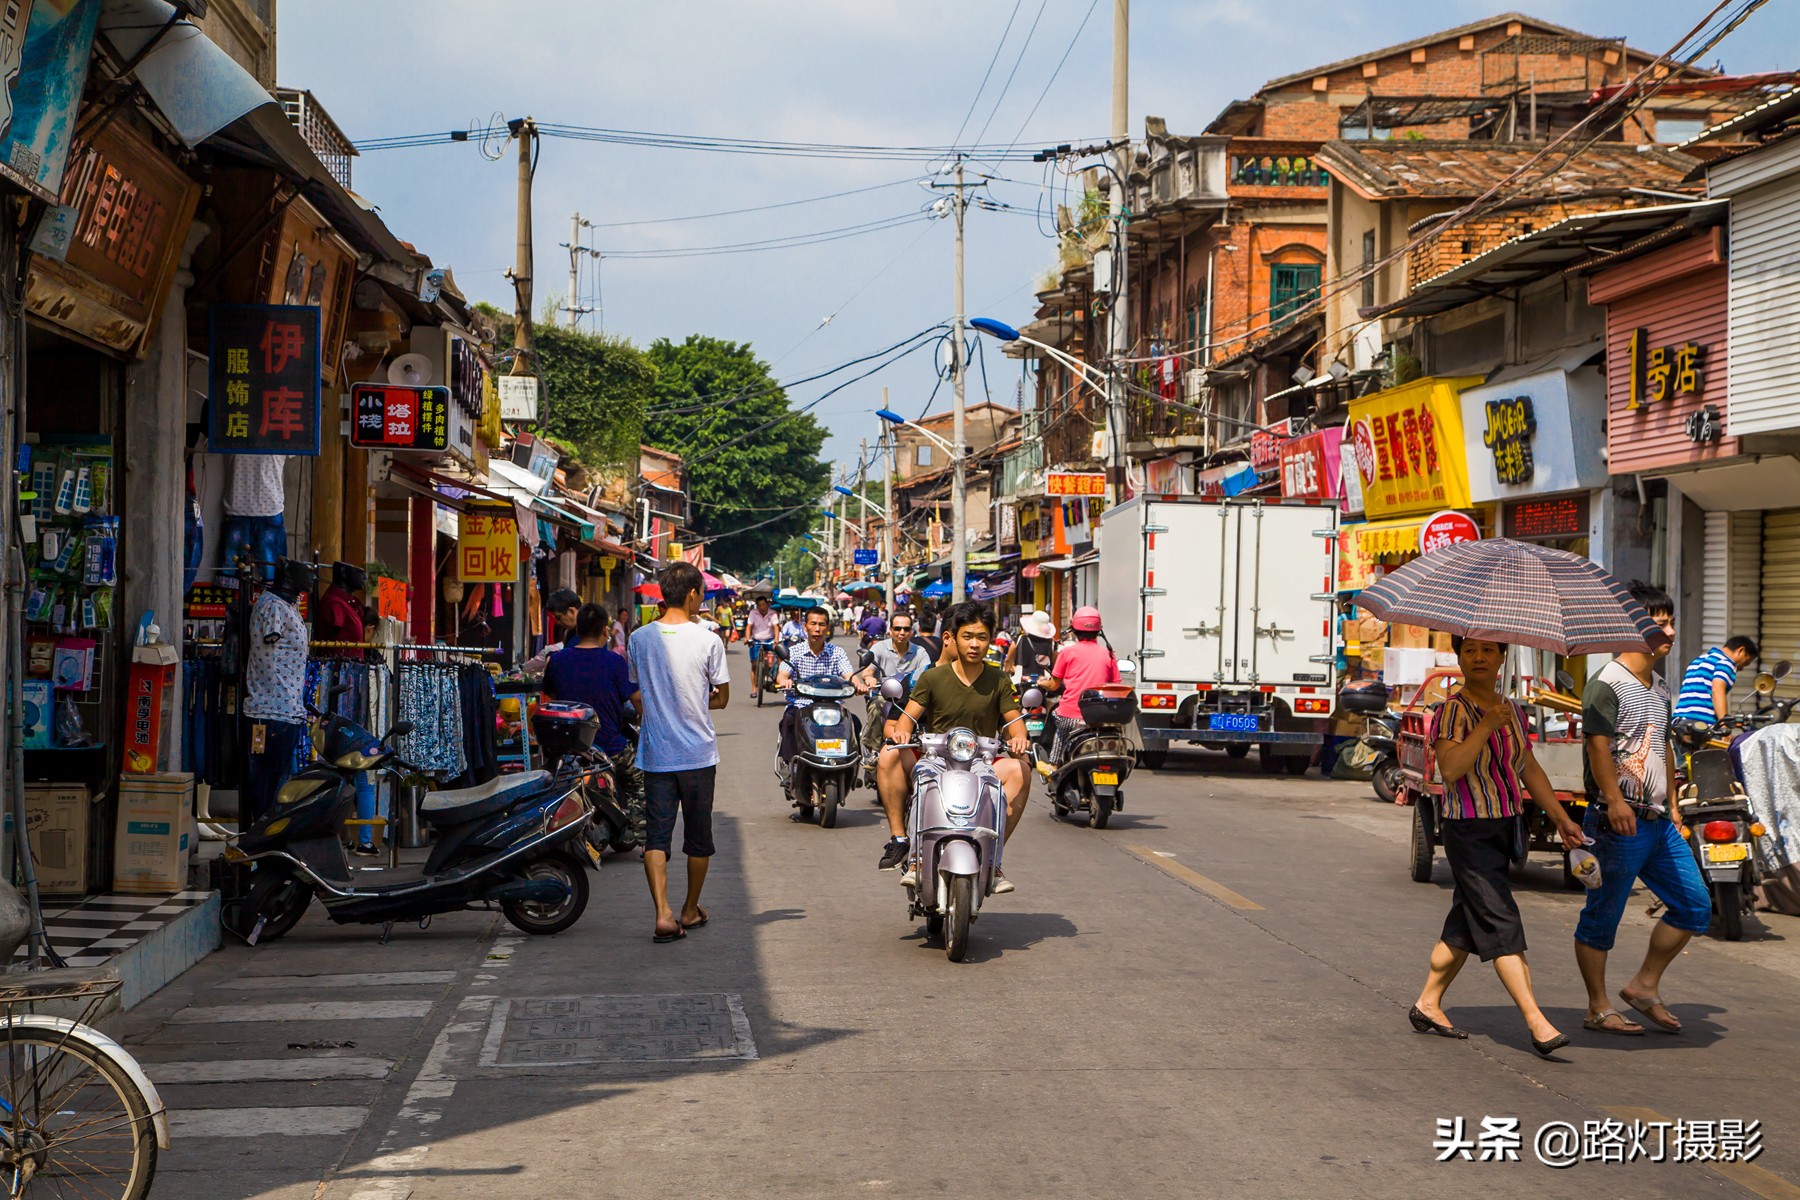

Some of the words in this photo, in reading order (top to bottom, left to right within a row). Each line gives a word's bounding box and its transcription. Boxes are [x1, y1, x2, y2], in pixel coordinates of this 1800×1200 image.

[225, 347, 250, 438] 服饰店
[258, 319, 306, 441] 伊库
[358, 396, 384, 430] 小栈
[387, 403, 412, 436] 塔拉
[421, 389, 434, 434] 绿植摆件
[433, 402, 446, 447] 多肉植物
[1372, 402, 1440, 482] 量贩零食
[1494, 440, 1527, 486] 杰米熊
[1048, 475, 1105, 494] 快餐超市
[1431, 521, 1454, 532] SNACK
[464, 546, 513, 577] 回收
[192, 596, 234, 604] 新品上市
[134, 695, 152, 744] 南孚电池
